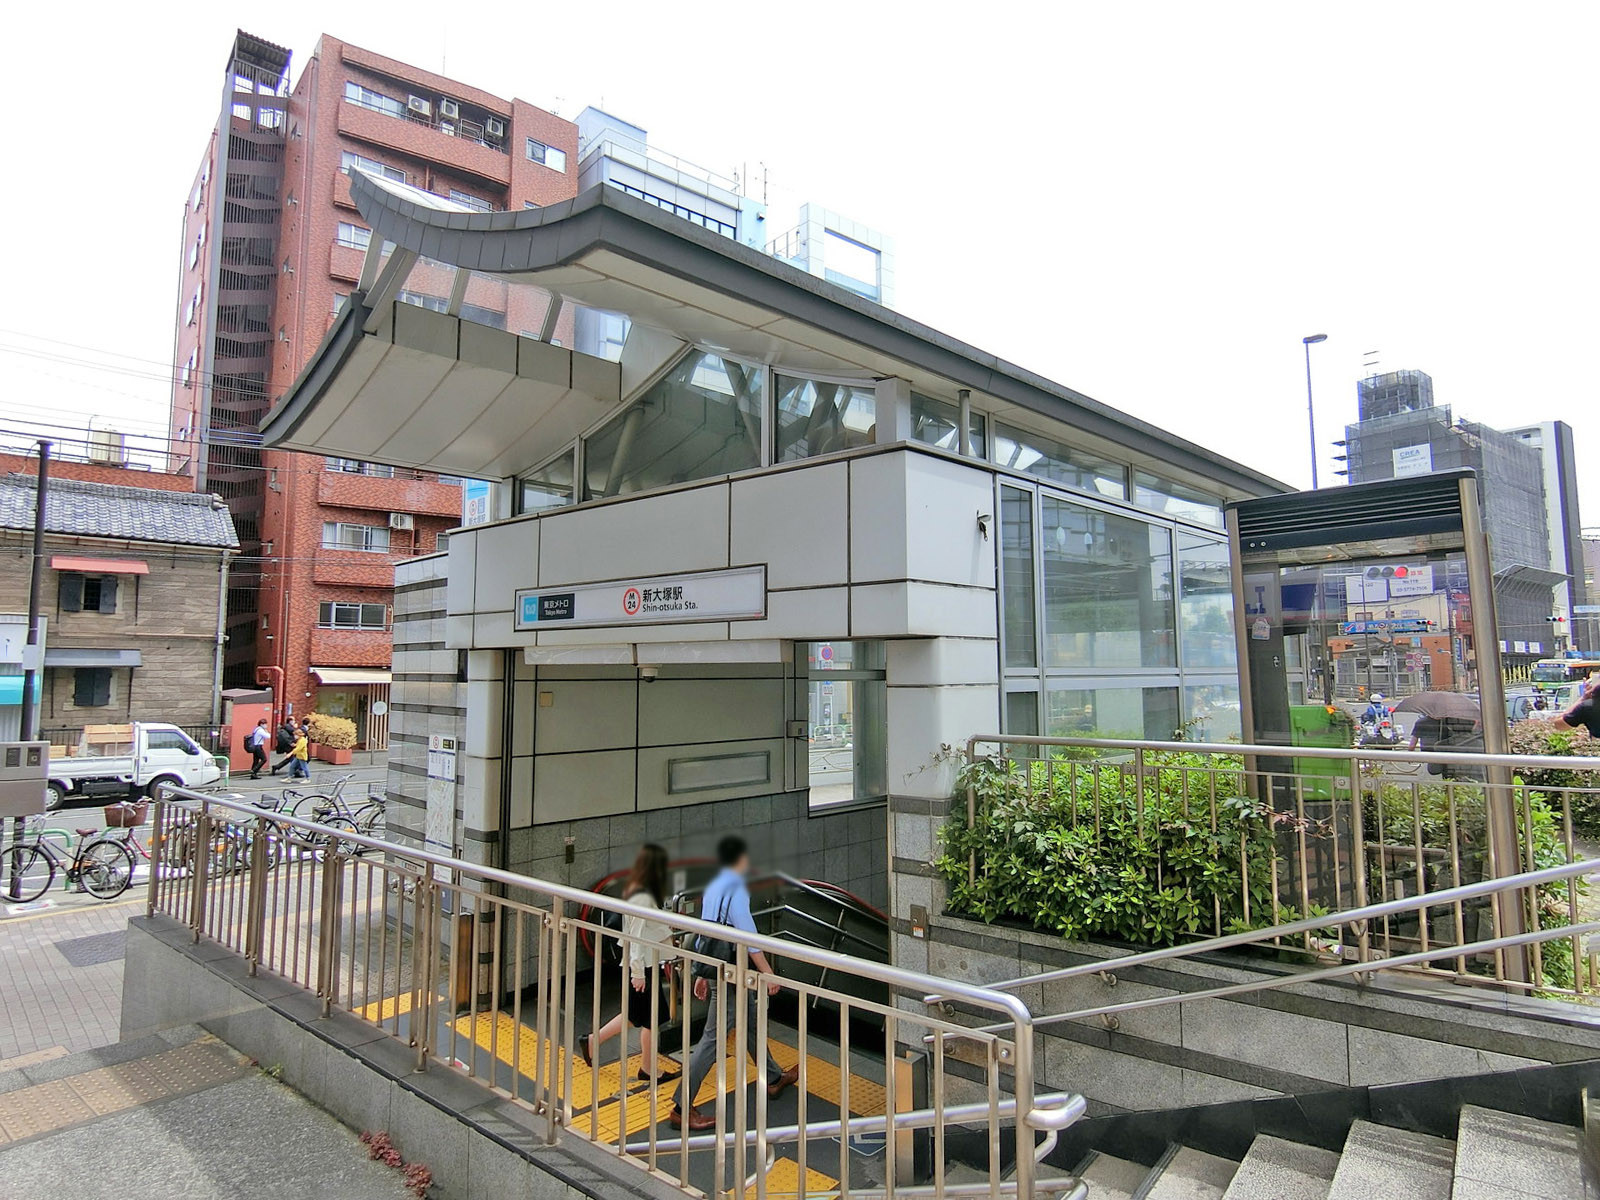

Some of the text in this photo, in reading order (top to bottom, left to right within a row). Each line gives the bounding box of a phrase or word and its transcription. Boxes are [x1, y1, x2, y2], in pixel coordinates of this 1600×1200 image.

[629, 592, 635, 600] M
[642, 586, 683, 603] 新大塚駅
[543, 599, 569, 609] 東京メトロ
[627, 601, 636, 610] 24
[642, 600, 699, 612] Shin-otsuka Sta.
